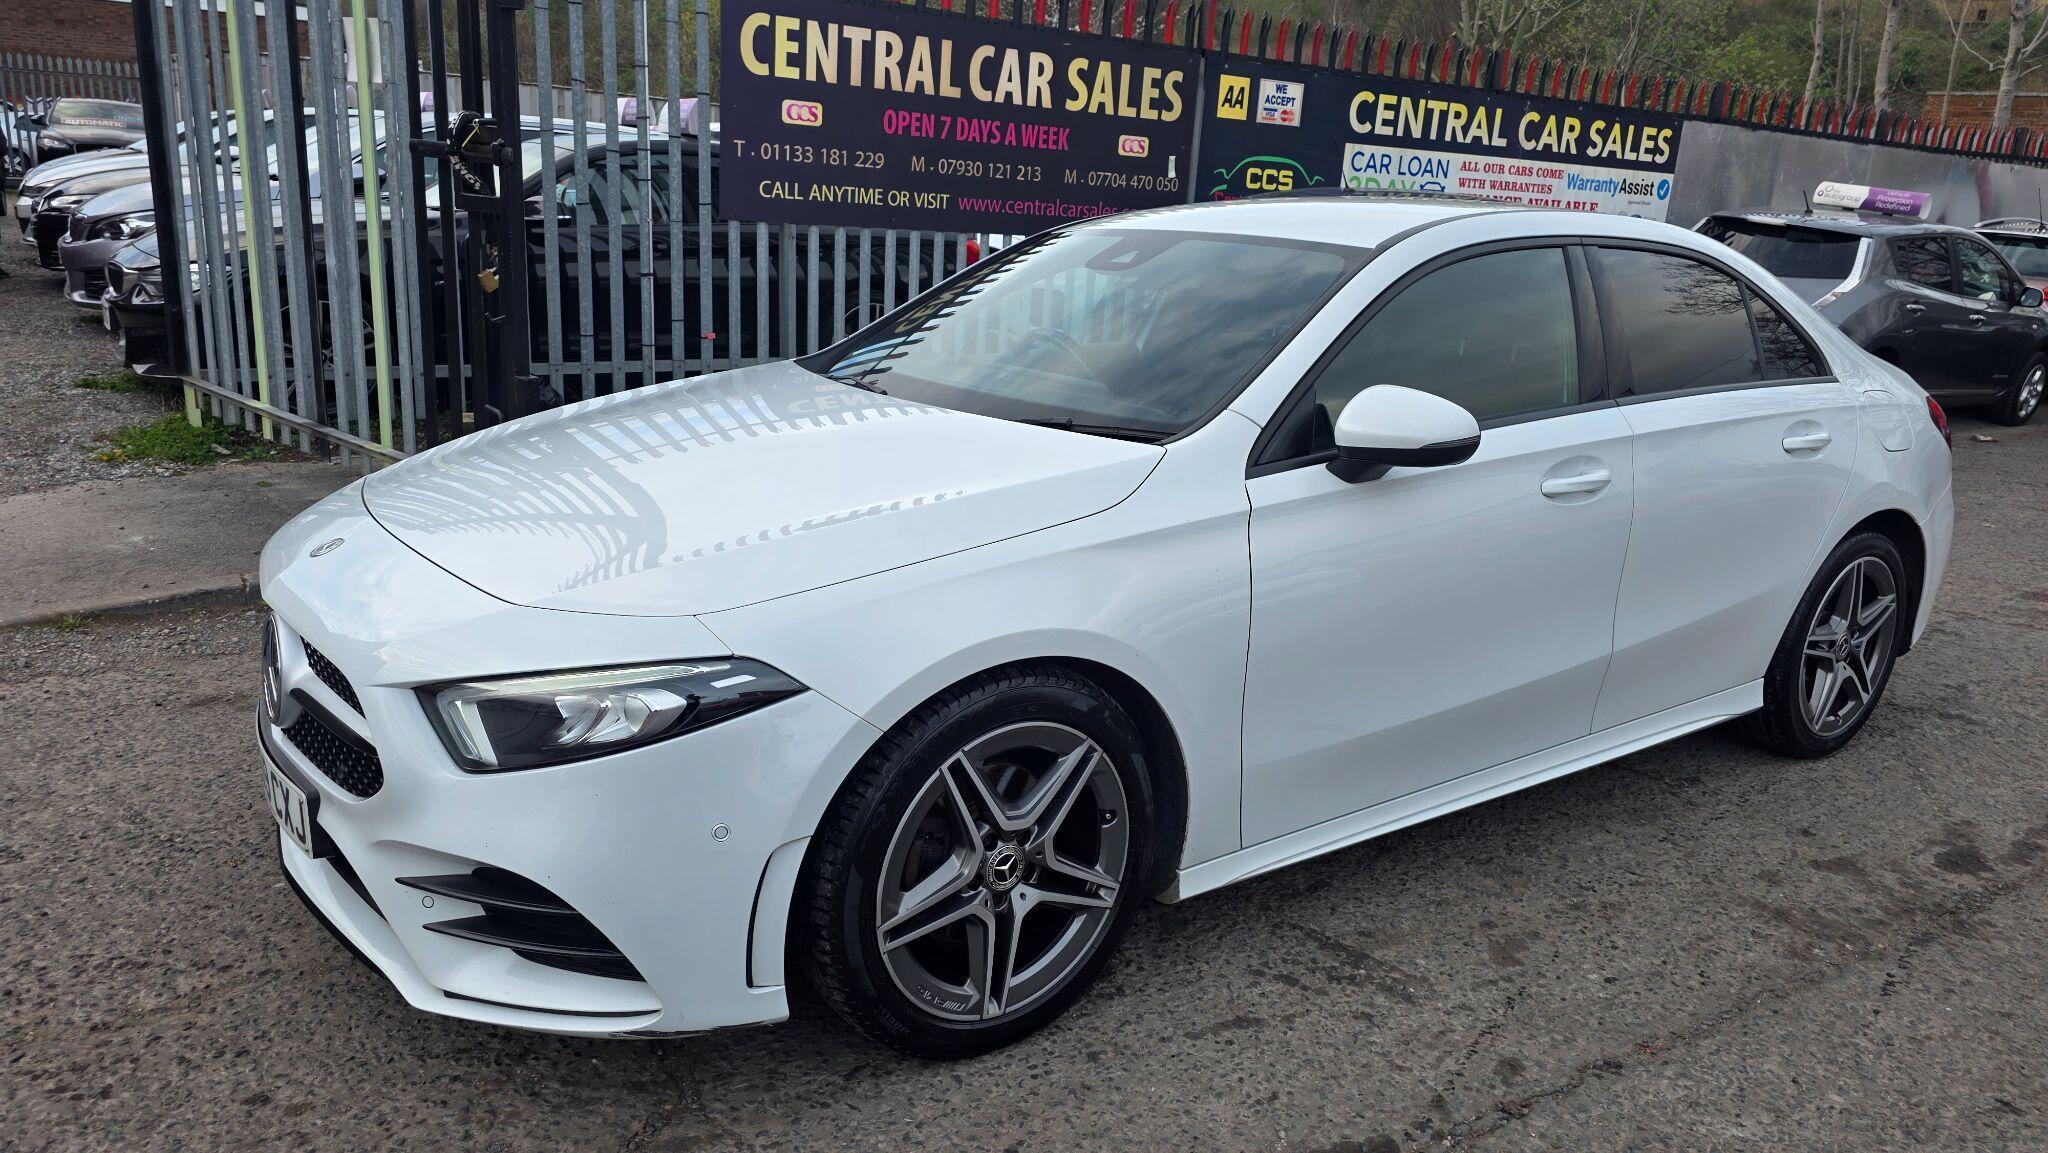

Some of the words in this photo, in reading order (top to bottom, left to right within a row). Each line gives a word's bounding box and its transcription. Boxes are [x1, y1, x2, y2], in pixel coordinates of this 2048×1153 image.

[740, 12, 961, 99] CENTRAL
[969, 45, 1054, 109] CAR
[1065, 57, 1184, 122] SALES
[1221, 85, 1245, 110] AA
[1264, 94, 1296, 108] ACCEPT
[1275, 83, 1288, 95] WE
[883, 109, 934, 138] OPEN
[940, 116, 952, 140] 7
[956, 117, 1001, 144] DAYS
[1005, 122, 1017, 146] A
[1021, 123, 1071, 150] WEEK
[1350, 91, 1507, 147] CENTRAL
[1518, 111, 1581, 155] CAR
[1587, 119, 1672, 164] SALES
[761, 143, 814, 164] 01133
[821, 148, 848, 166] 181
[854, 151, 885, 169] 229
[1351, 151, 1392, 175] CAR
[1397, 155, 1450, 179] LOAN
[938, 158, 983, 177] 07930
[988, 162, 1011, 179] 121
[1016, 165, 1042, 182] 213
[1088, 171, 1127, 189] 07704
[1130, 175, 1153, 190] 470
[1156, 177, 1179, 192] 050
[1245, 167, 1294, 191] CCS
[1459, 160, 1481, 173] ALL
[1483, 163, 1505, 176] OUR
[1508, 164, 1534, 178] CARS
[1536, 167, 1565, 180] COME
[759, 180, 804, 200] CALL
[809, 184, 884, 206] ANYTIME
[888, 190, 910, 207] OR
[914, 192, 950, 210] VISIT
[1458, 177, 1490, 190] WITH
[1493, 179, 1553, 195] WARRANTIES
[1823, 192, 1861, 203] autogroup
[1875, 202, 1911, 212] Redefined
